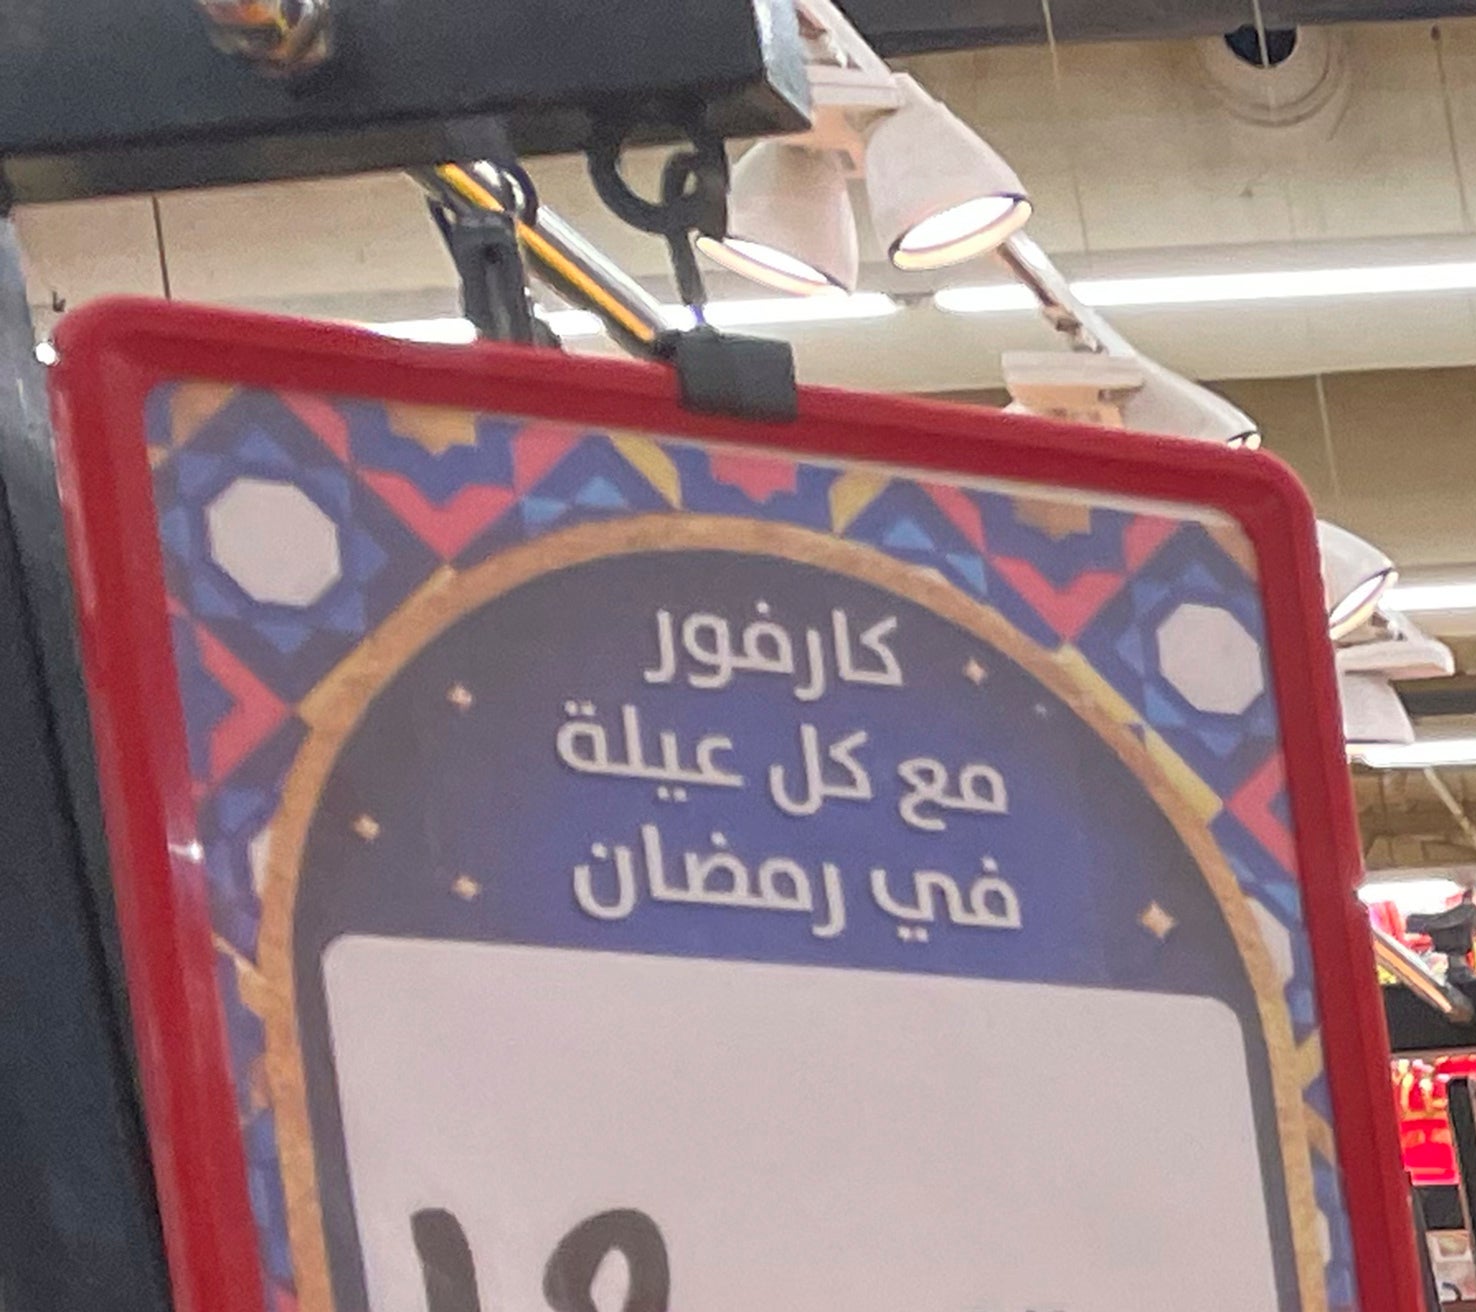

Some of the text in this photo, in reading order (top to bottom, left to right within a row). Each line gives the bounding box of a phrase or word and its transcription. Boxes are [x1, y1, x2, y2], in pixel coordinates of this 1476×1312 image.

[643, 600, 903, 700] كارفور
[556, 701, 1009, 831] مع كل عيلة
[573, 823, 1022, 942] في رمضان
